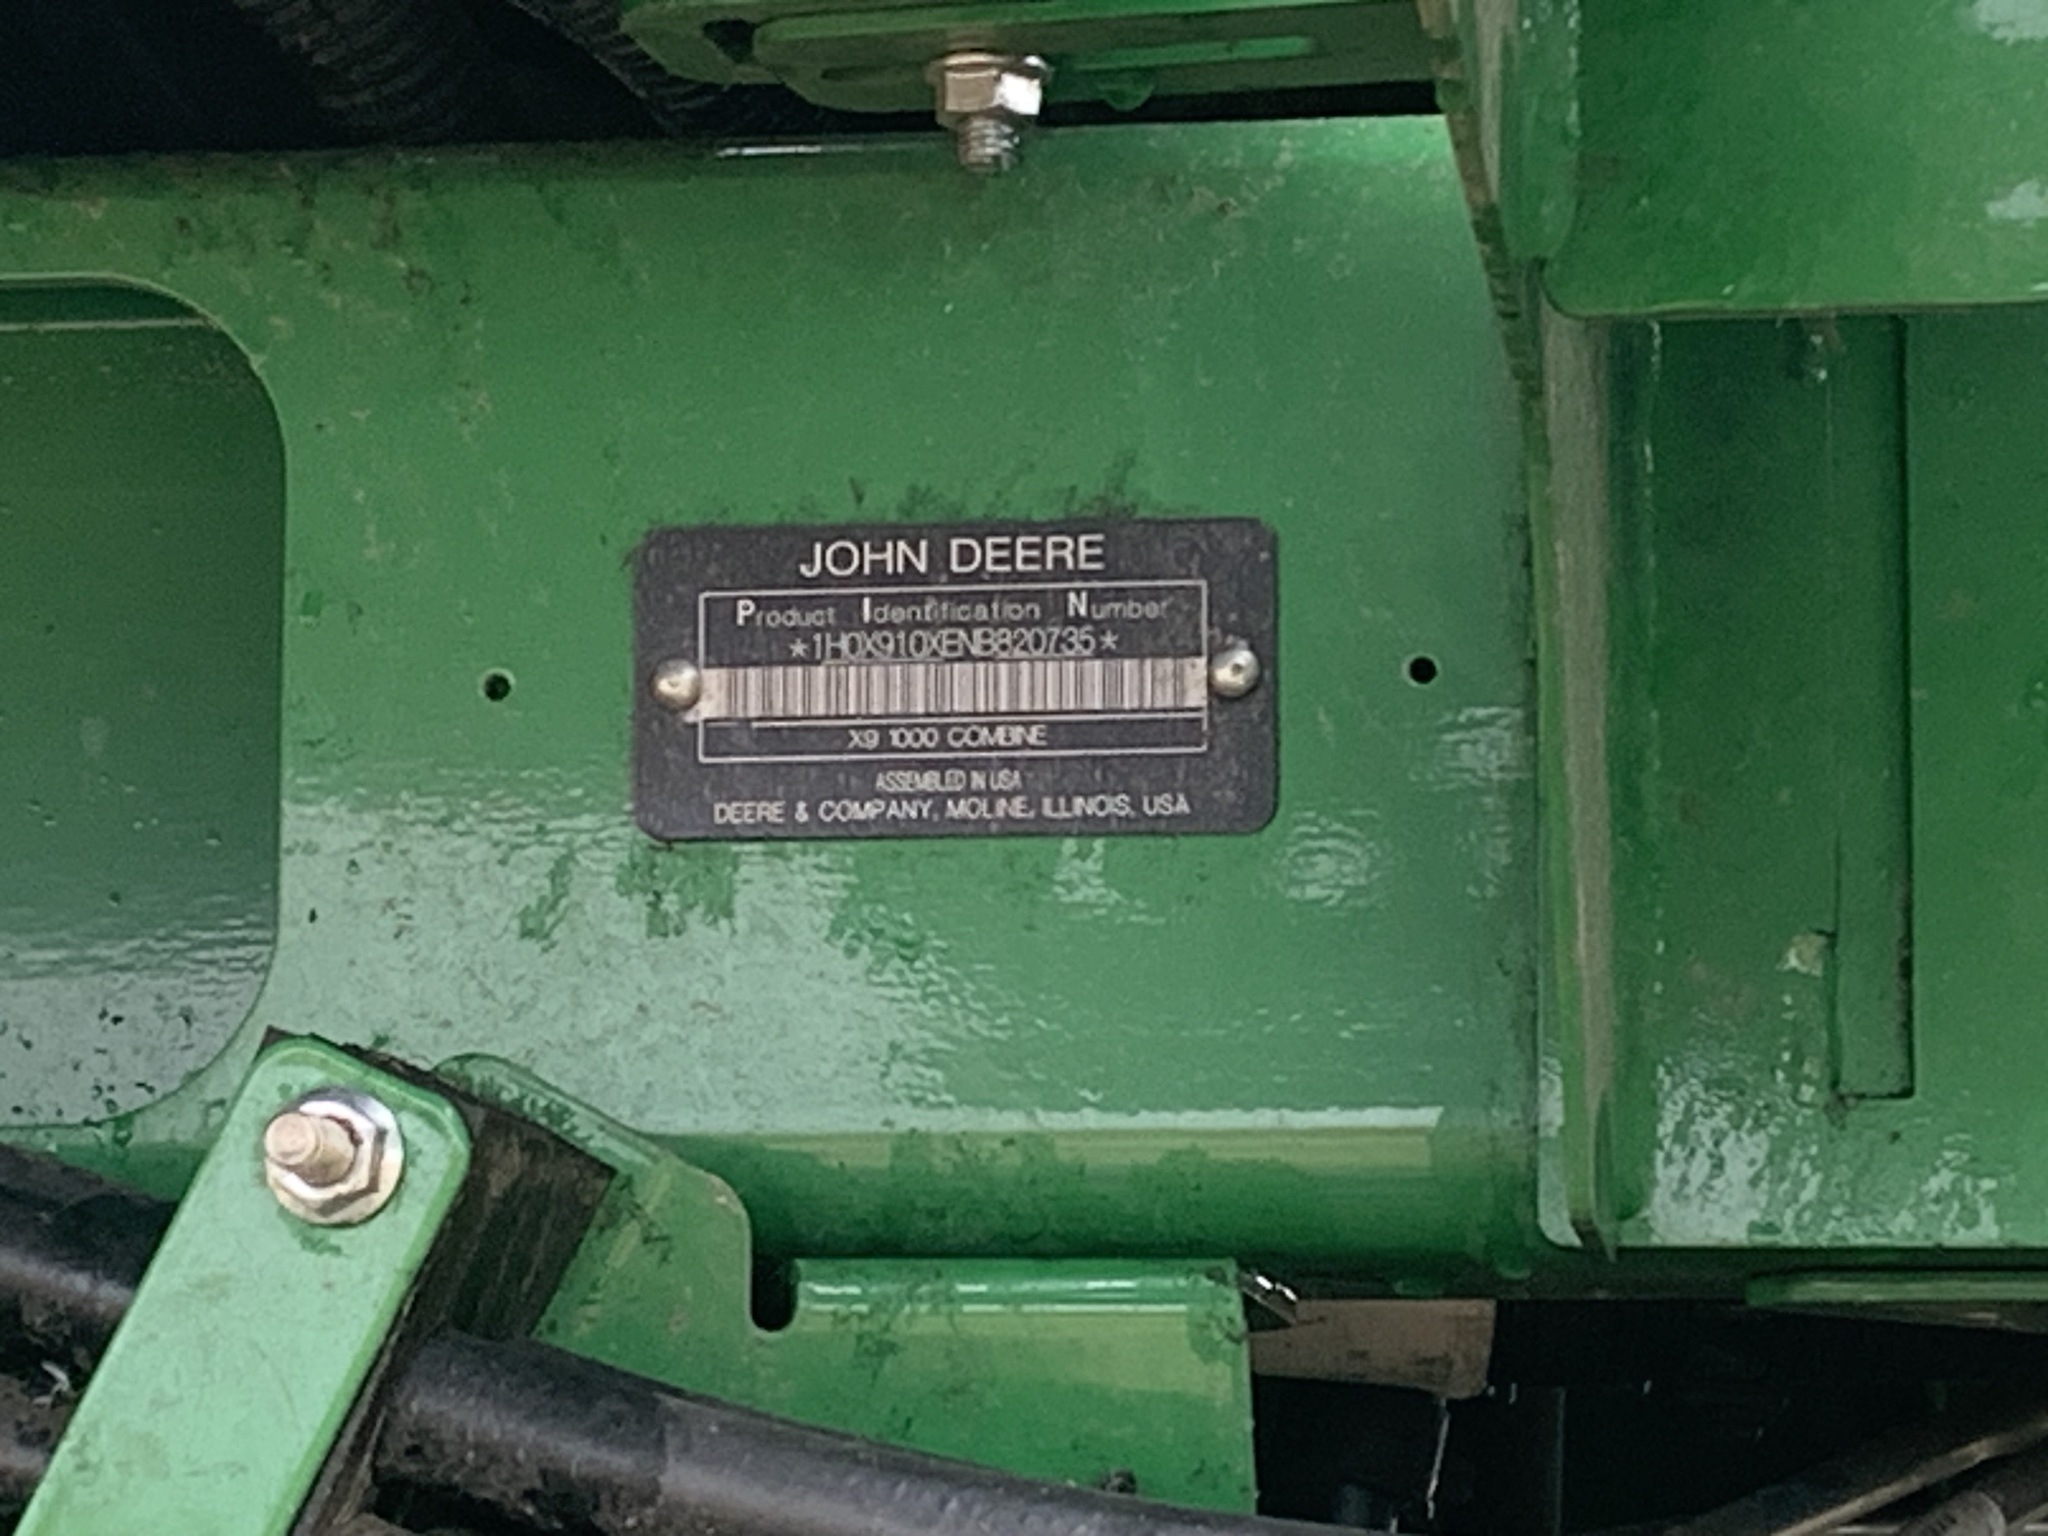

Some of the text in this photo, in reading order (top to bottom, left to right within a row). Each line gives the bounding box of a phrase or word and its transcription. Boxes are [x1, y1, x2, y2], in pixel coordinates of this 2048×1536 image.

[800, 534, 1105, 577] JOHN DEERE
[736, 590, 1169, 626] Product Identification Number
[848, 724, 1047, 749] X9 1000 COMBINE
[875, 768, 1022, 792] ASSEMBLED IN USA
[713, 801, 785, 824] DEERE
[794, 803, 809, 823] &
[1142, 793, 1191, 816] USA
